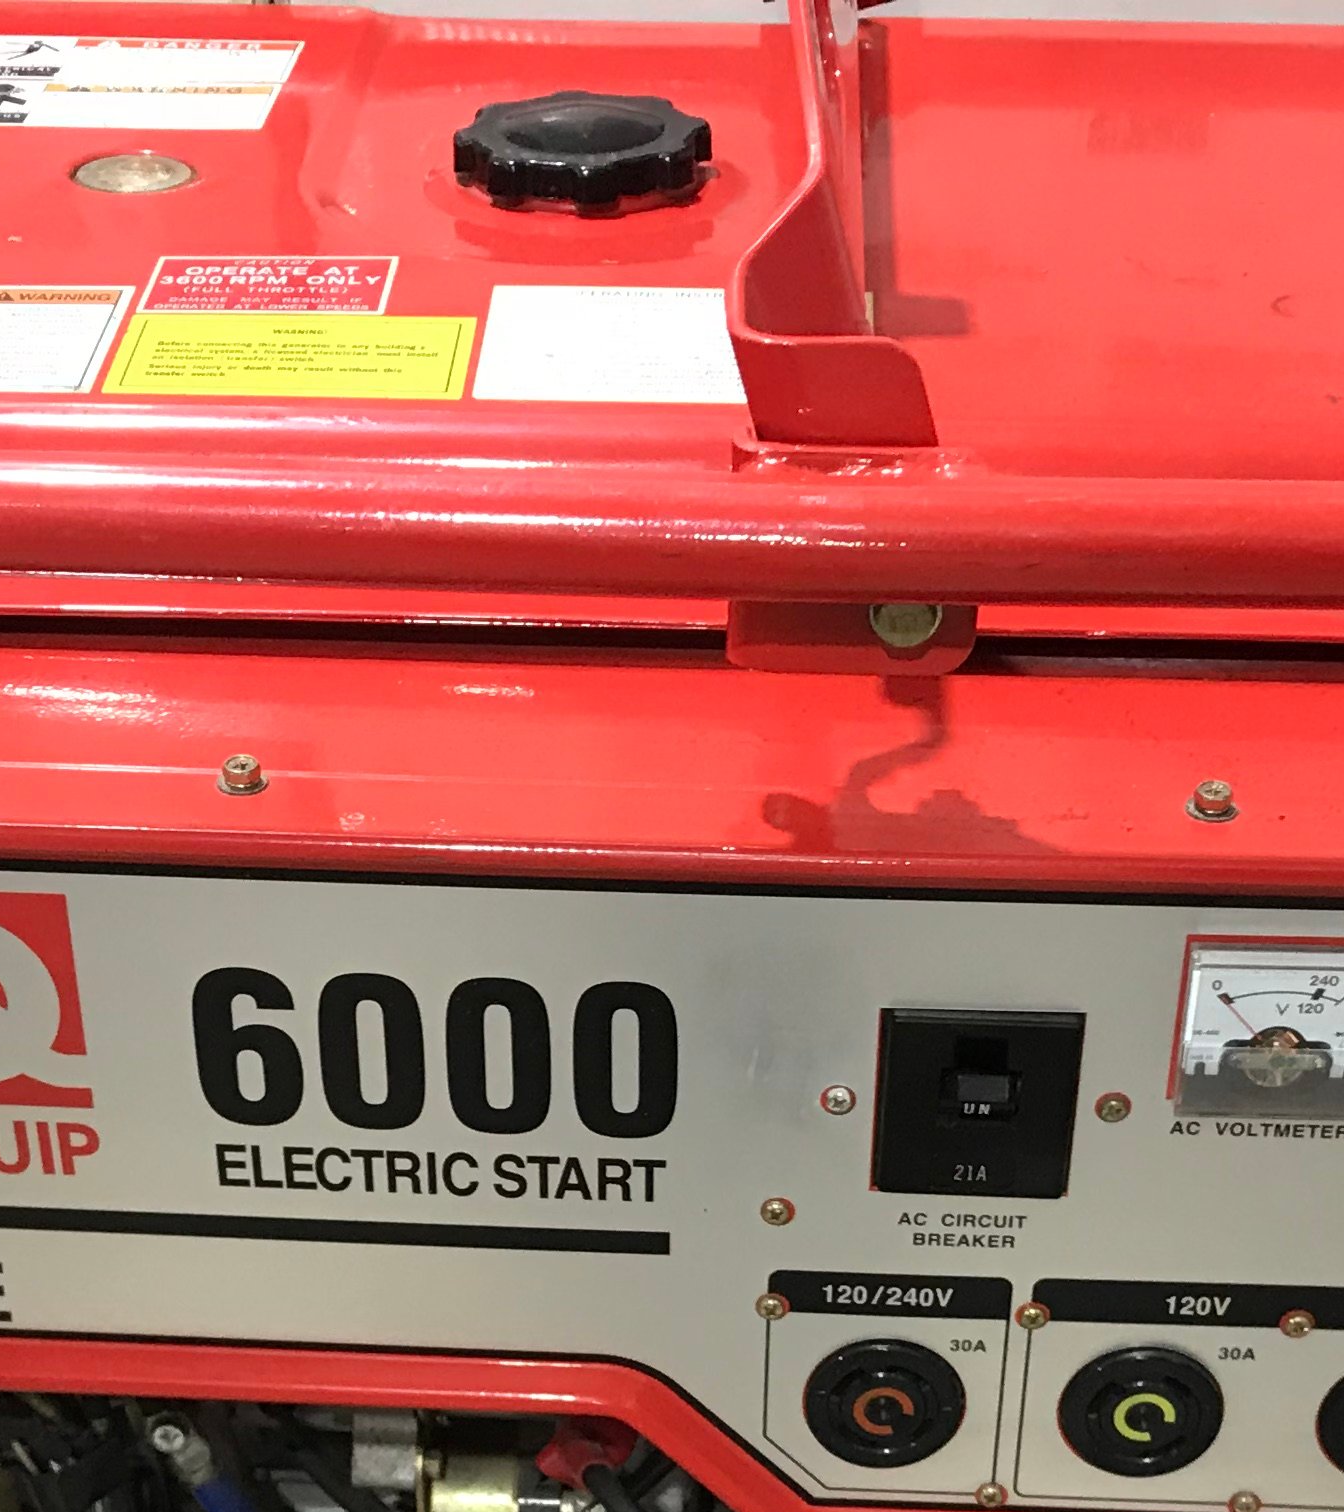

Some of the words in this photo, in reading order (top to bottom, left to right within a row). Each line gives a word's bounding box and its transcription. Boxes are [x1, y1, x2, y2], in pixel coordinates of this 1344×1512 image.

[185, 266, 309, 276] OPERATE
[323, 266, 360, 276] AT
[160, 276, 224, 285] 3600
[229, 276, 288, 285] RPM
[306, 276, 382, 285] ONLY
[19, 292, 112, 302] WARNING
[183, 286, 234, 294] (FULL
[248, 286, 349, 294] THROTTLE)
[1212, 980, 1223, 991] 0
[1310, 975, 1340, 987] 240
[1276, 1003, 1290, 1016] V
[1297, 1003, 1325, 1014] 120
[192, 966, 679, 1138] 6000
[1170, 1120, 1201, 1136] AC
[215, 1143, 479, 1197] ELECTRIC
[493, 1153, 667, 1202] START
[953, 1165, 988, 1182] 21A
[898, 1212, 928, 1227] AC
[941, 1213, 1028, 1229] CIRCUIT
[913, 1232, 1016, 1249] BREAKER
[822, 1284, 954, 1307] 120/240V
[1165, 1296, 1233, 1317] 120V
[950, 1339, 986, 1353] 30A
[1217, 1347, 1256, 1361] 30A
